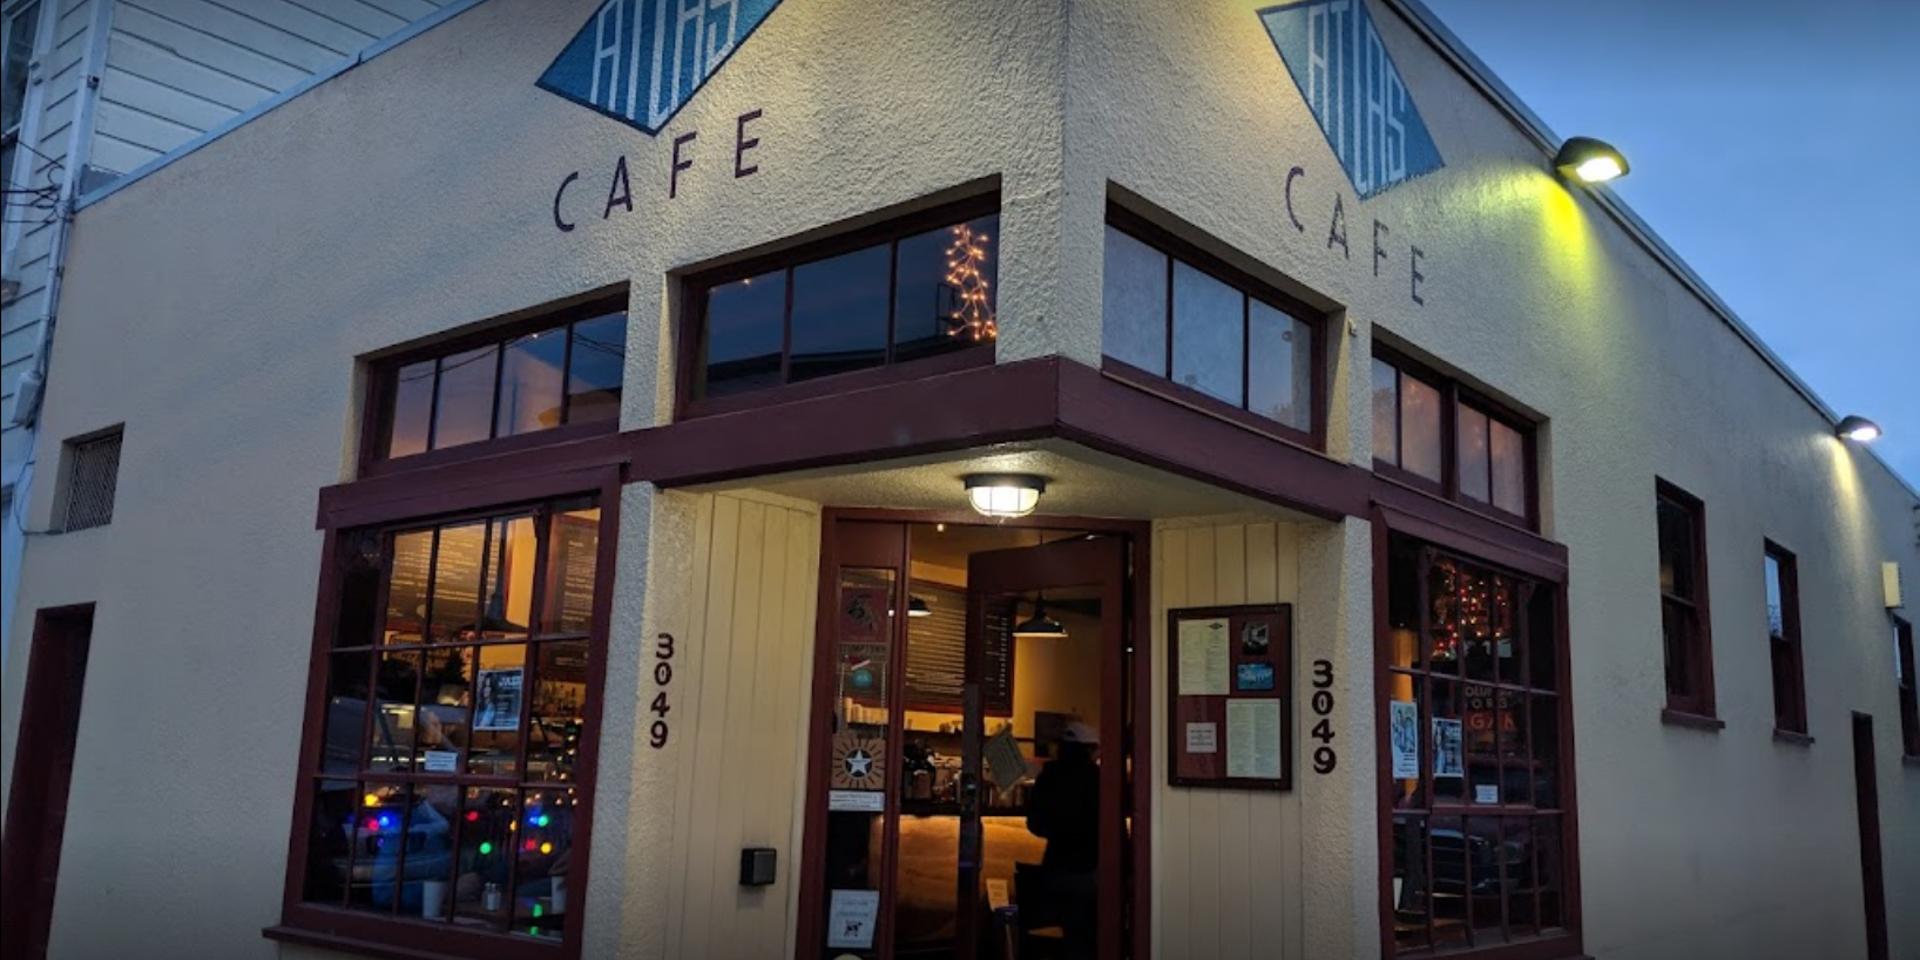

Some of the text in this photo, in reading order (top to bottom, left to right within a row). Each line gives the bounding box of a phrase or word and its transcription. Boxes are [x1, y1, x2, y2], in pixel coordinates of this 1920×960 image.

[1307, 0, 1406, 195] ATLAS
[553, 108, 763, 233] CAFE
[1285, 166, 1424, 306] CAFE
[650, 632, 675, 750] 3049
[1311, 659, 1337, 775] 3049
